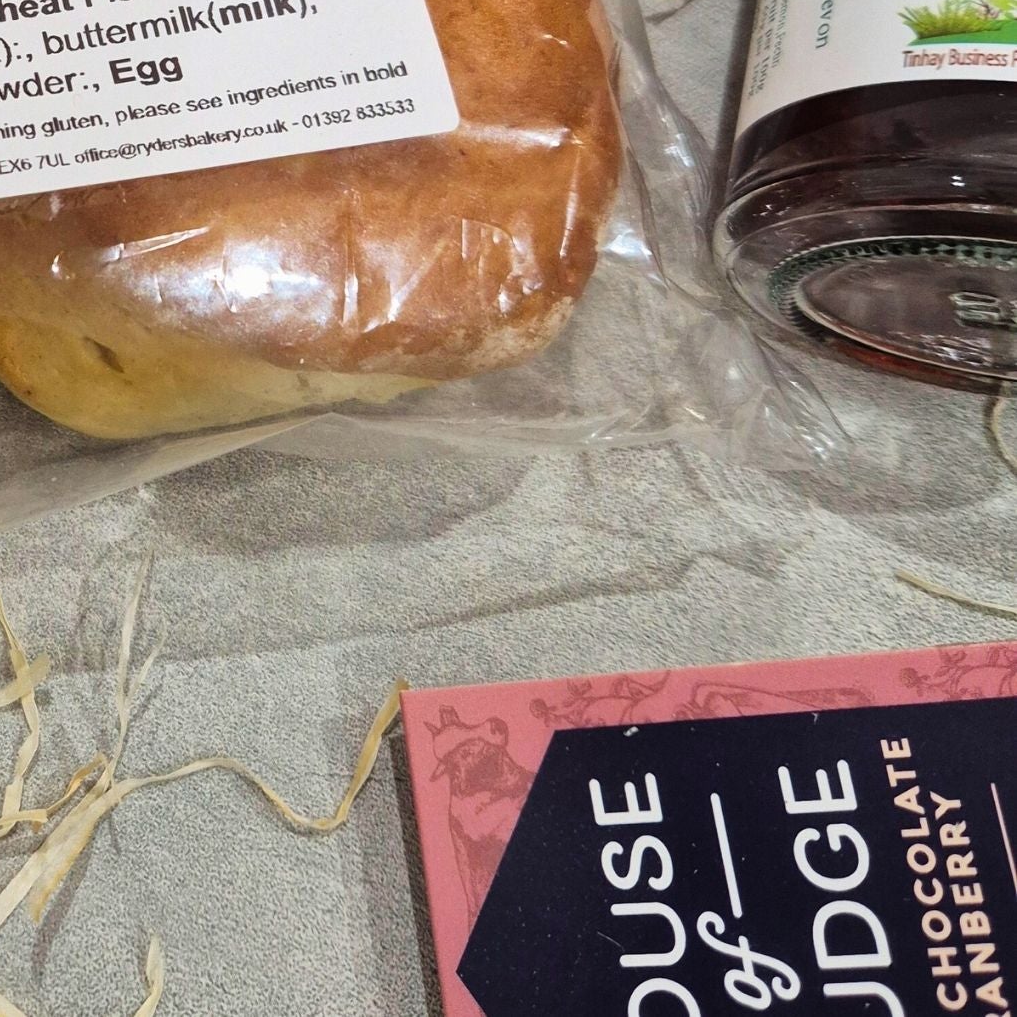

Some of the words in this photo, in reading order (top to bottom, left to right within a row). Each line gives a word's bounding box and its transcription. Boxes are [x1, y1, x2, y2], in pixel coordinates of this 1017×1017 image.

[109, 55, 184, 87] Egg
[902, 49, 945, 70] Tinhay
[949, 48, 1008, 67] Business
[37, 152, 70, 170] 7UL
[74, 118, 288, 165] office@rydersbakery.co.uk
[302, 108, 352, 129] 01392
[356, 98, 415, 120] 833533
[41, 113, 110, 137] gluten,
[115, 102, 181, 126] please
[186, 96, 223, 112] see
[227, 76, 337, 106] ingredients
[340, 69, 360, 85] in
[363, 61, 408, 82] bold
[880, 737, 969, 1012] CHOCOLATE
[697, 910, 802, 1012] of
